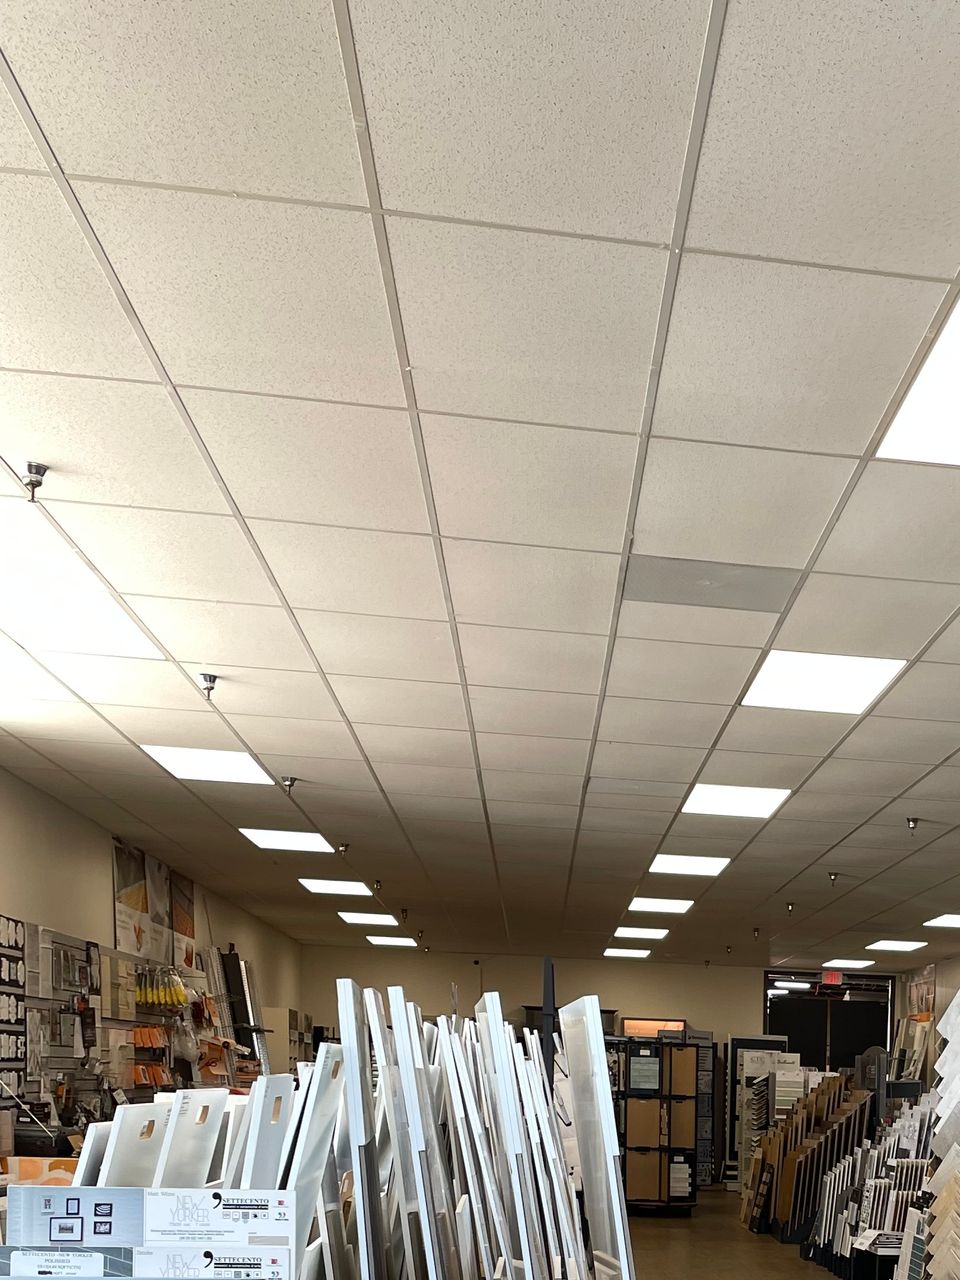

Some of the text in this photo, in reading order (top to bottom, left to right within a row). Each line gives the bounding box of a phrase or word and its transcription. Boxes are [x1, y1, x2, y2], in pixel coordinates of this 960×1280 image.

[176, 1195, 206, 1210] NEW
[169, 1207, 210, 1223] YORKER
[166, 1254, 197, 1269] NEW
